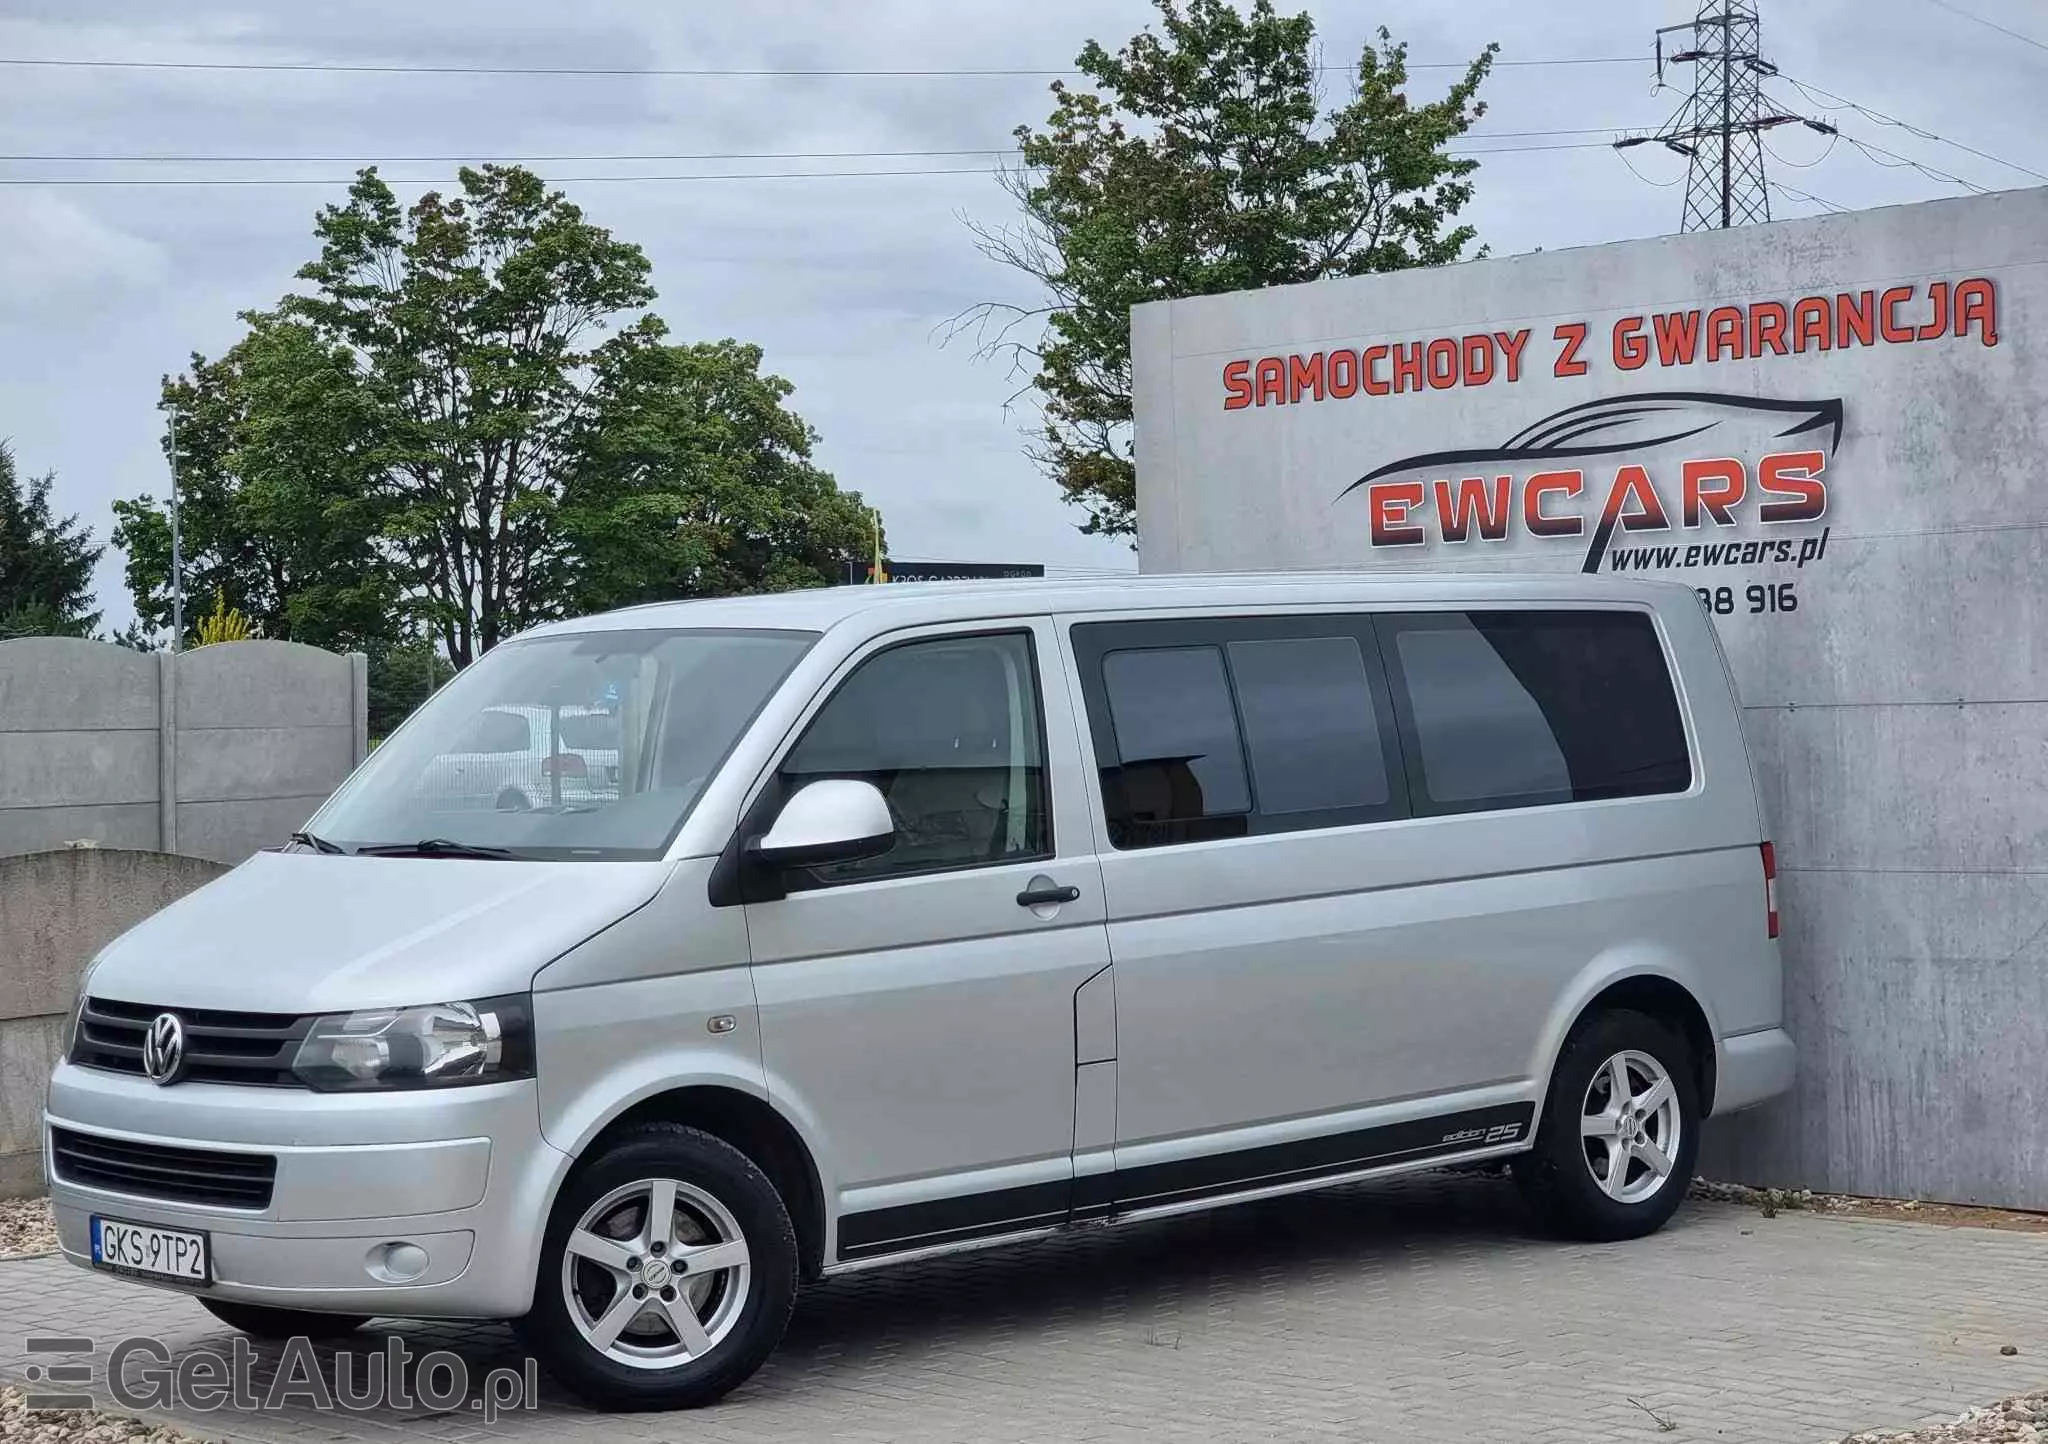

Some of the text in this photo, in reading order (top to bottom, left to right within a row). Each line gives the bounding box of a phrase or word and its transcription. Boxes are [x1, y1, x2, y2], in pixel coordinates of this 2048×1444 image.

[1223, 278, 1999, 410] SAMOCHODY Z GWARANCJĄ
[1369, 450, 1827, 574] EWCARS
[1611, 527, 1831, 571] www.ewcars.pl
[1746, 583, 1798, 613] 916
[1483, 1122, 1523, 1143] 25
